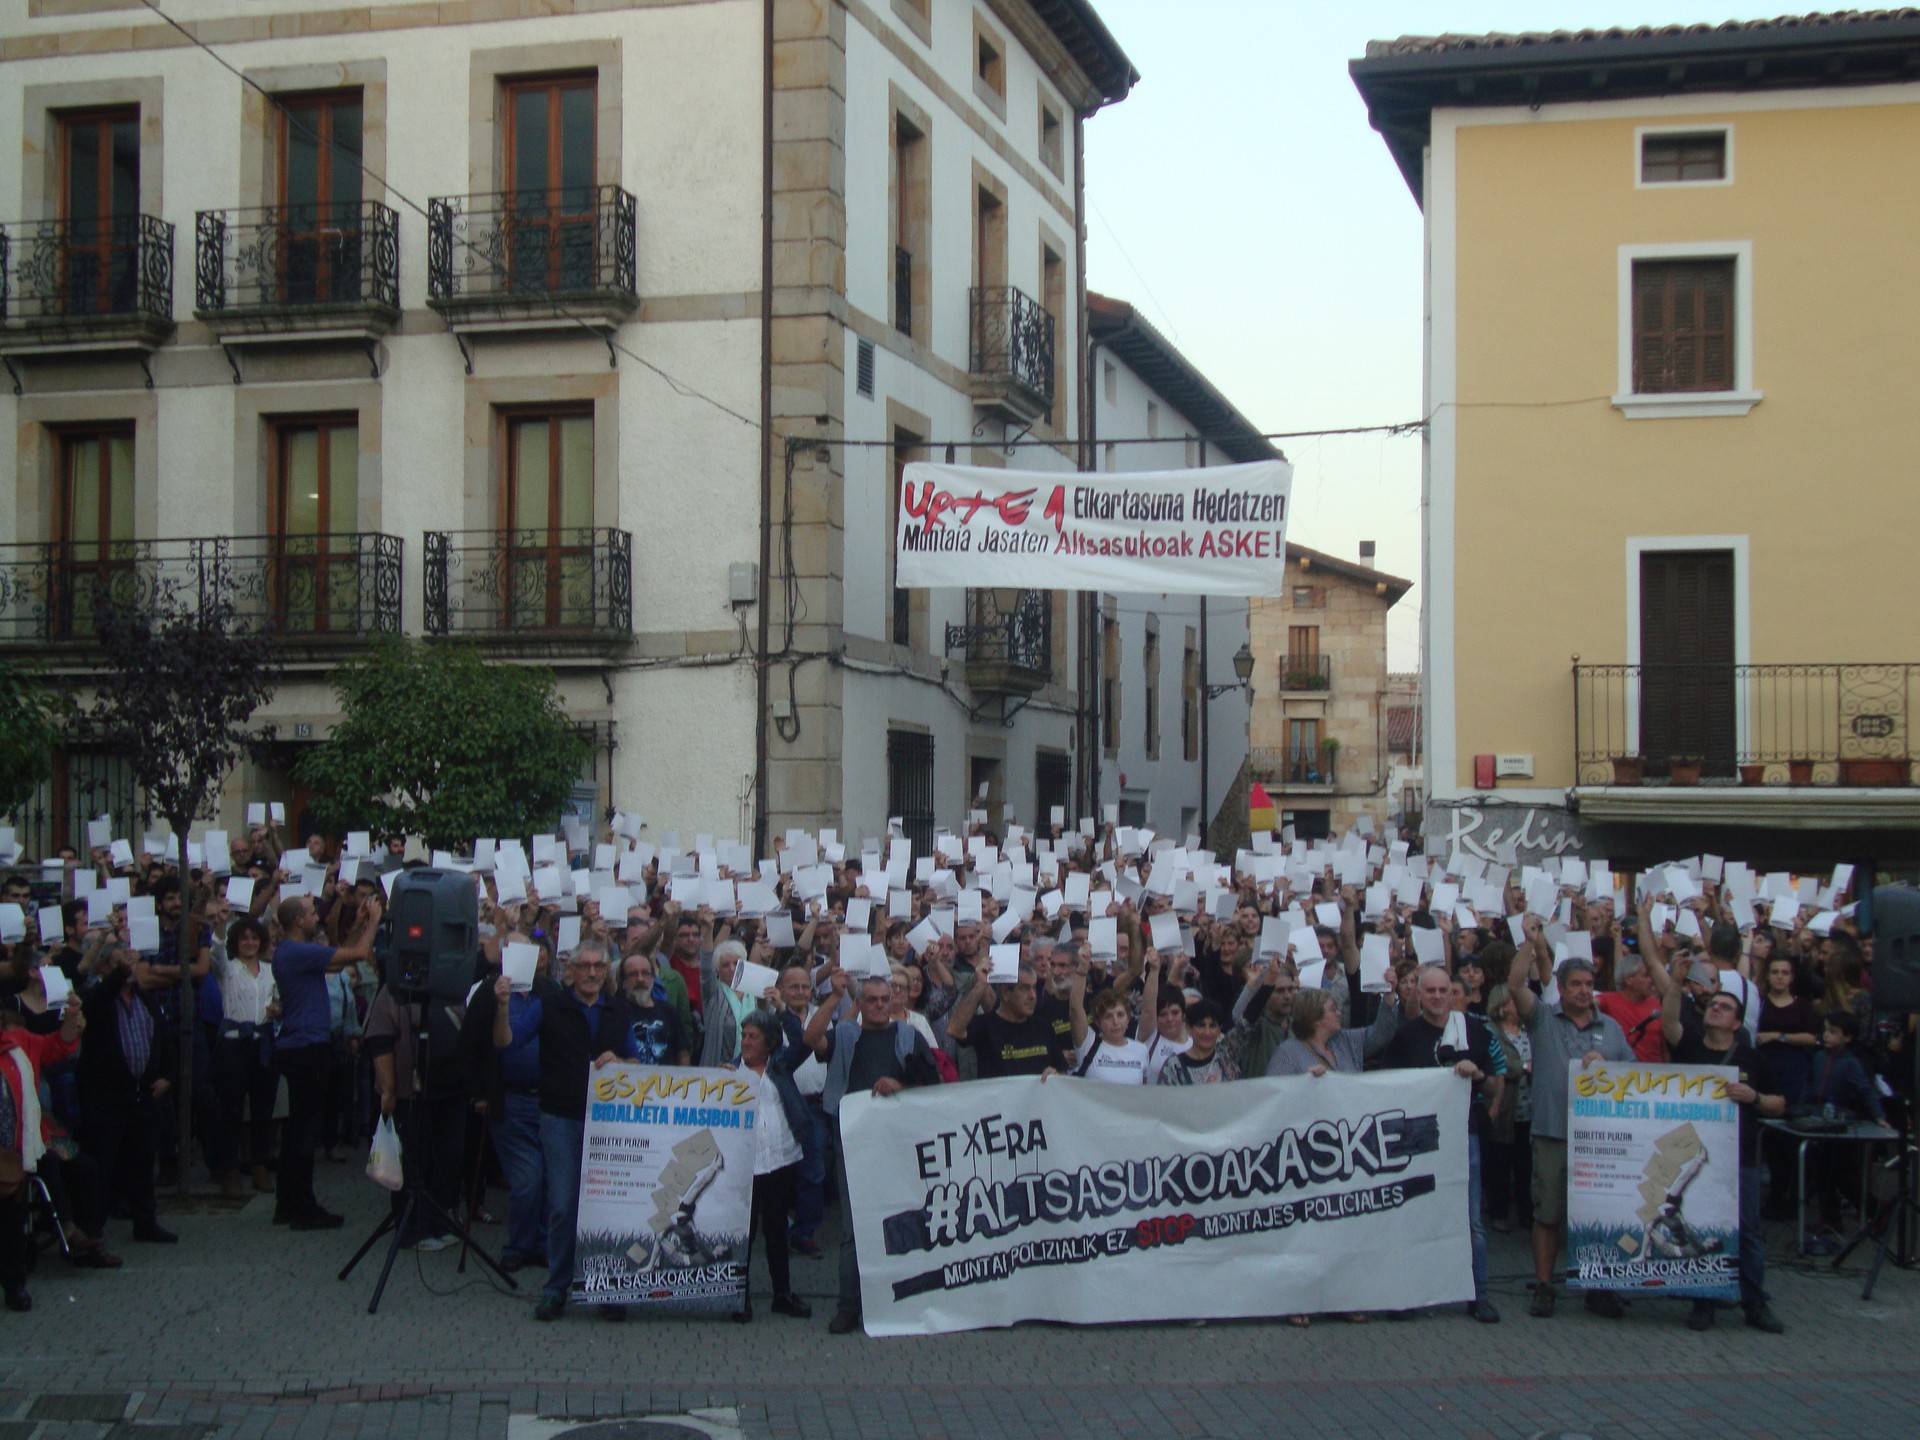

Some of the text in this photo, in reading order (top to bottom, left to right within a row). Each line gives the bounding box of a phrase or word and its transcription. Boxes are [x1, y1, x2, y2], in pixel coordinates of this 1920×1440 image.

[1043, 485, 1065, 533] 1
[1074, 487, 1285, 525] Elkartasuna Hedatzen
[978, 525, 1049, 554] Jasaten
[1053, 529, 1282, 558] Altsasukoak ASKE!
[1446, 807, 1583, 864] Redin
[592, 1103, 668, 1125] BIDALKETA
[673, 1107, 740, 1129] MASIBOA
[1573, 1098, 1650, 1119] BIDALKETA
[1654, 1102, 1721, 1122] MASIBOA
[915, 1114, 1047, 1180] ETXERA
[926, 1109, 1411, 1245] #ALTSASUKOAKASKE
[943, 1186, 1404, 1287] MUNTAI POLIZIALIK EZ STOP MONTAJES POLICIALES
